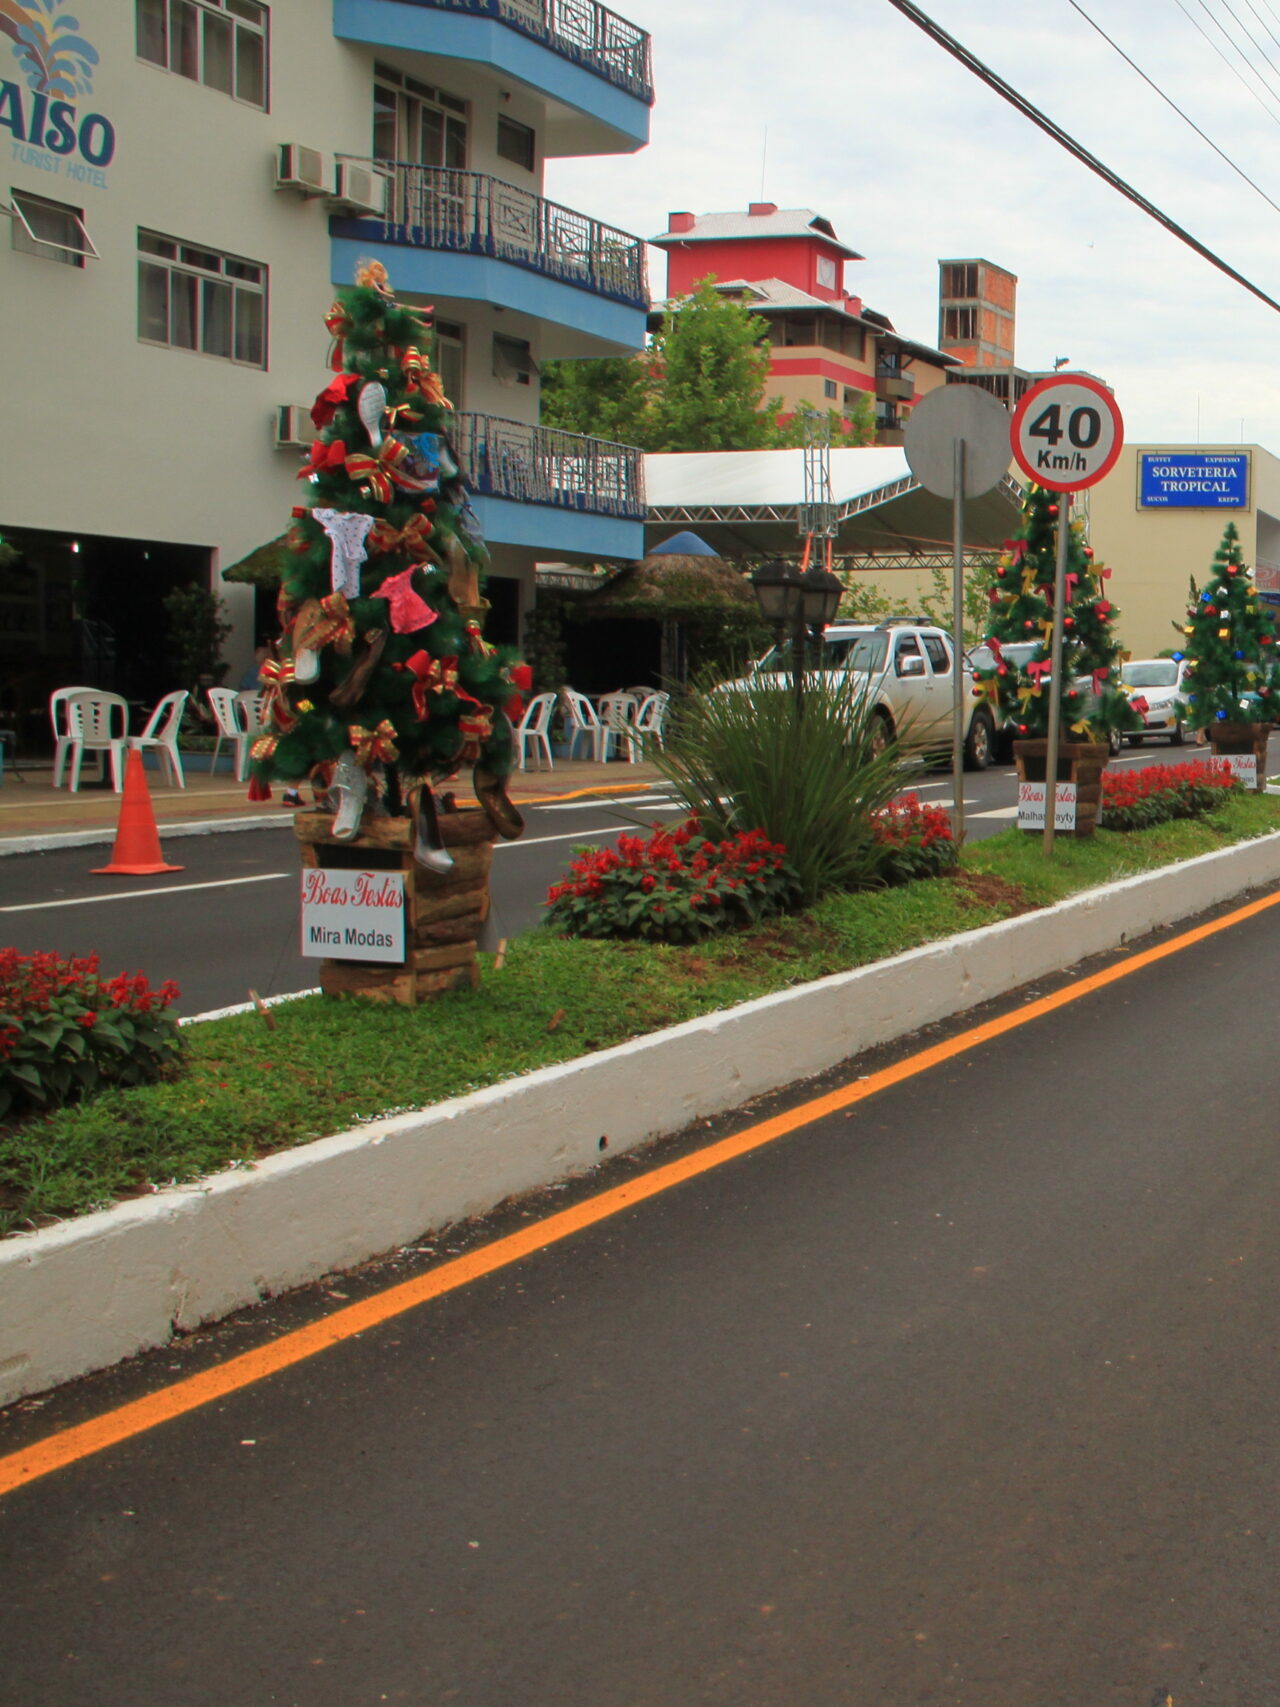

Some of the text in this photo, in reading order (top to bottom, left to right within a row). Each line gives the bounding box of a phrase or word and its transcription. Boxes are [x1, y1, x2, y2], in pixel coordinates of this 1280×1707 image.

[11, 142, 109, 190] TURIST HOTEL
[1029, 404, 1101, 449] 40
[1037, 449, 1087, 471] Km/h
[1152, 466, 1237, 478] SORVETERIA
[1161, 481, 1230, 492] TROPICAL
[302, 869, 403, 909] Boas Festas
[310, 926, 394, 948] Mira Modas
